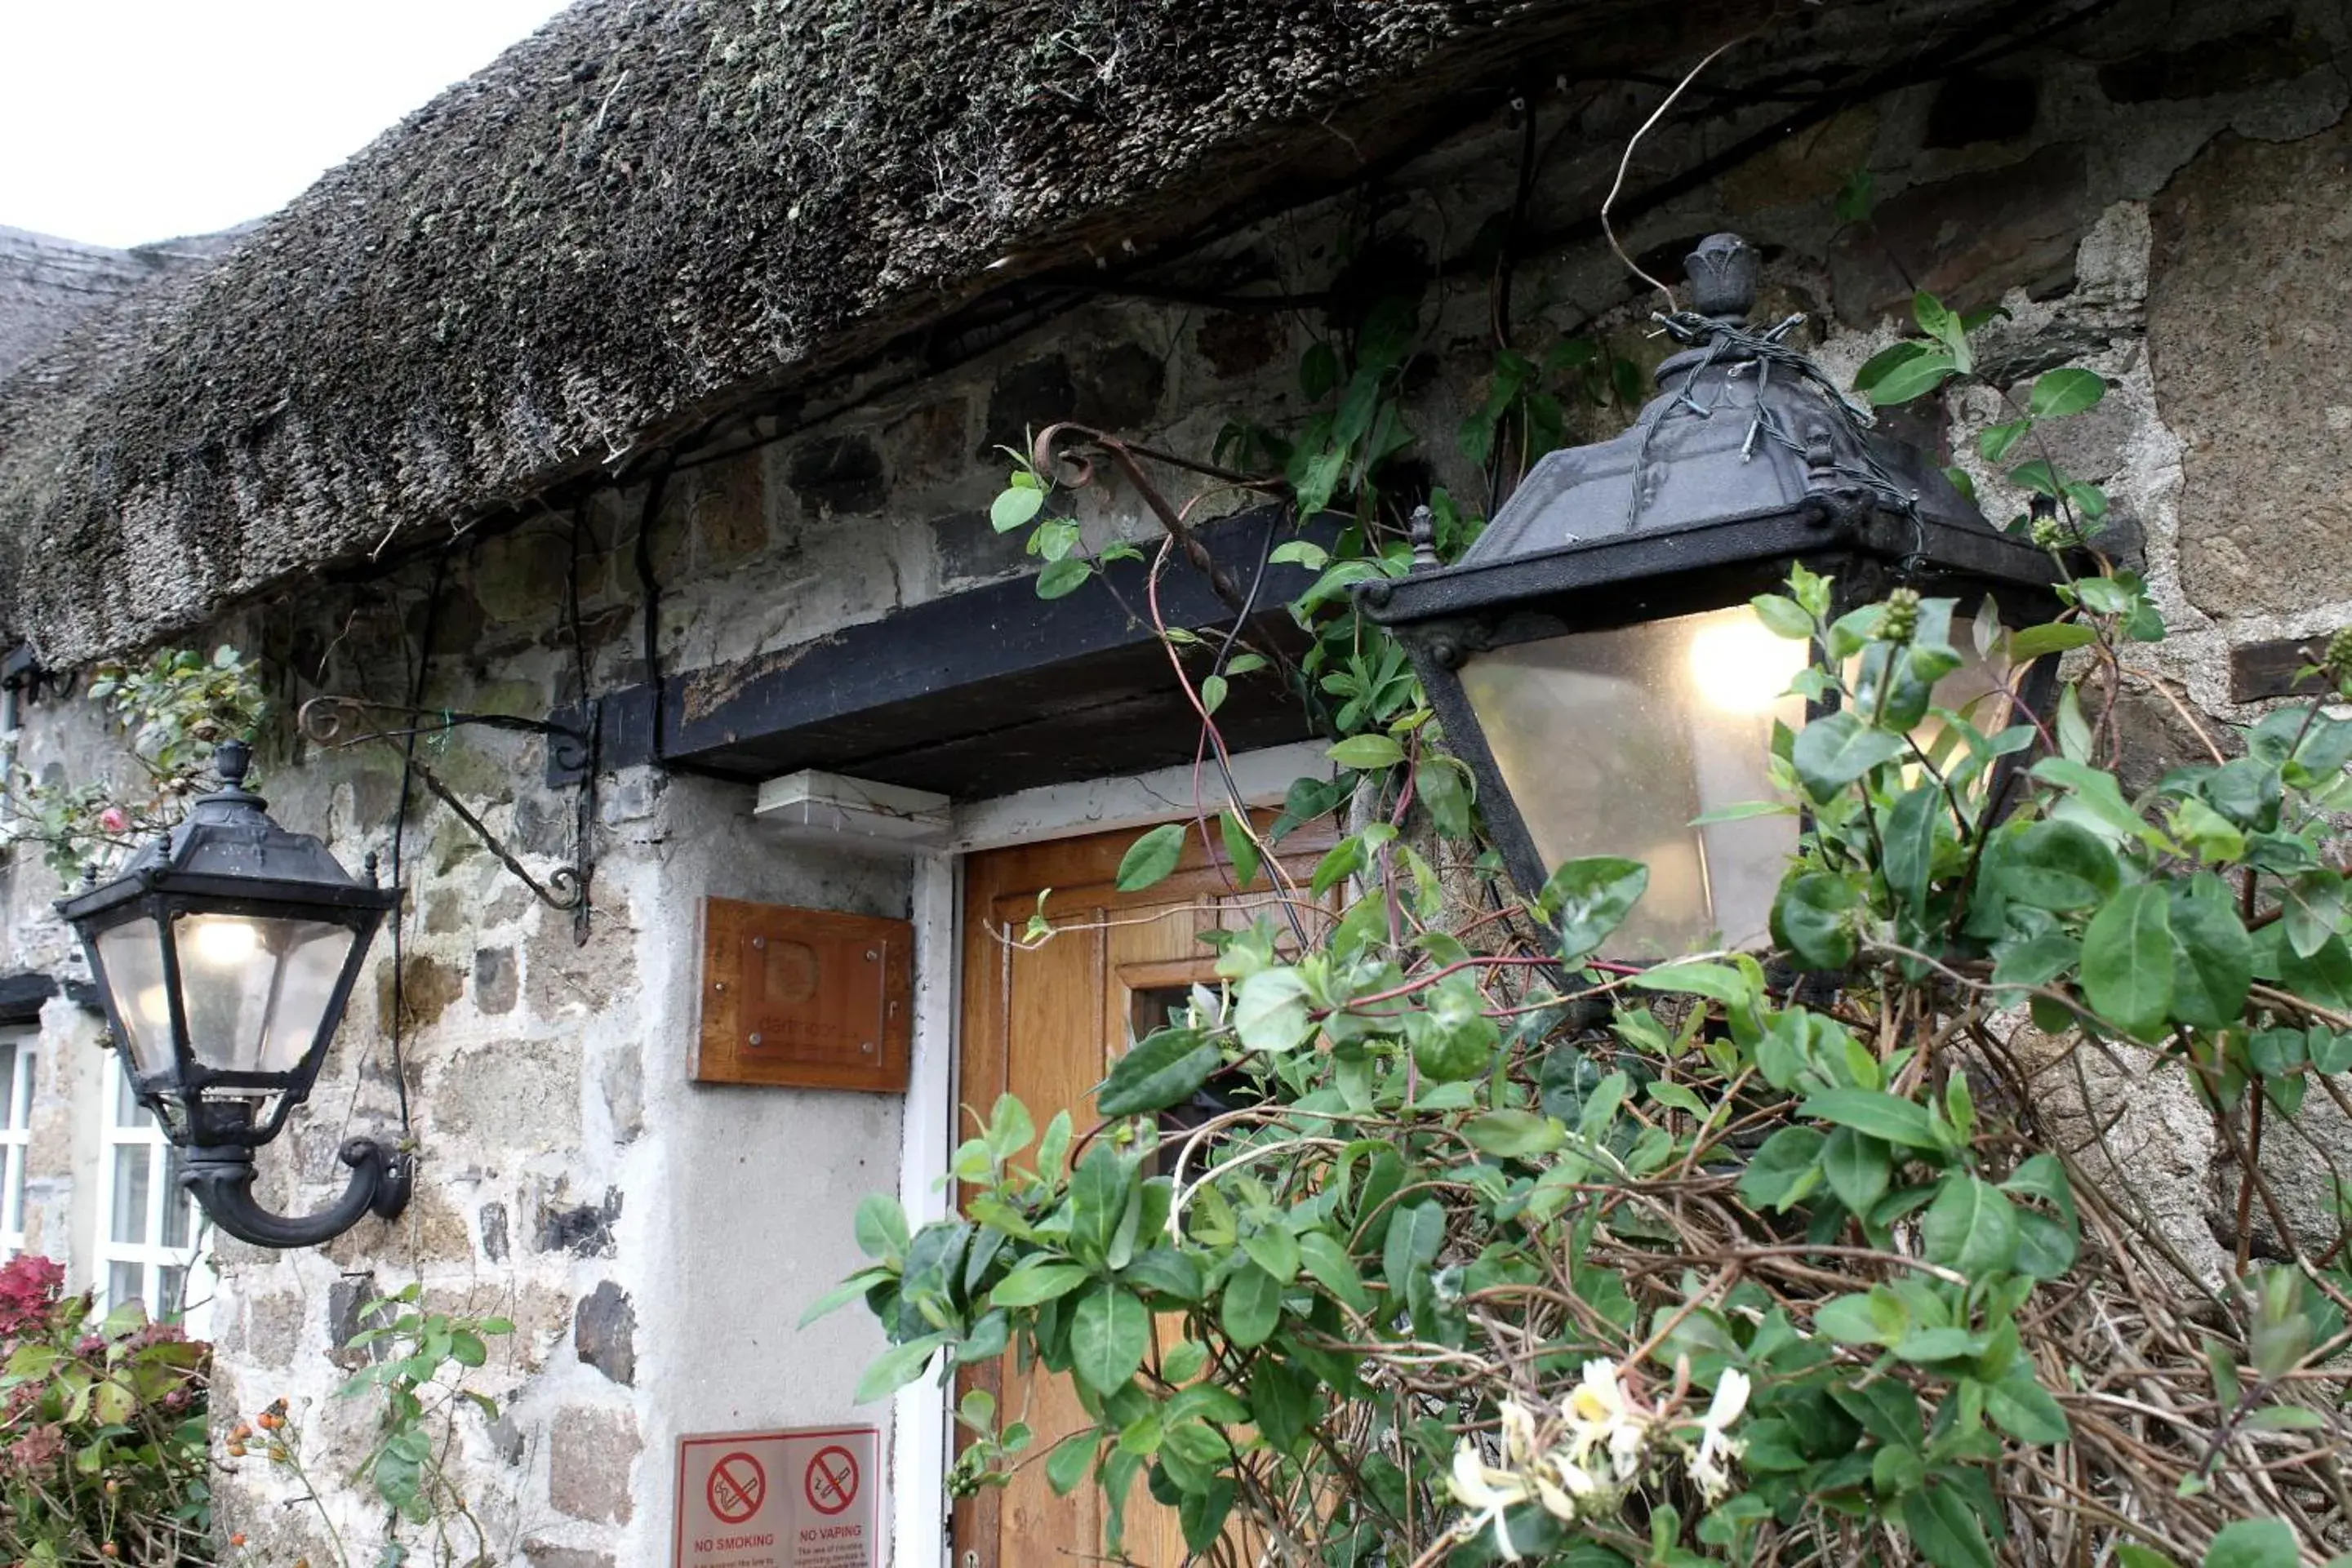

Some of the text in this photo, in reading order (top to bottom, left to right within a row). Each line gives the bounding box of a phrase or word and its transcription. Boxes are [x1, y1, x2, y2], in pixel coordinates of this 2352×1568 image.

[799, 1525, 862, 1542] NO VAPING
[694, 1534, 774, 1552] NO SMOKING
